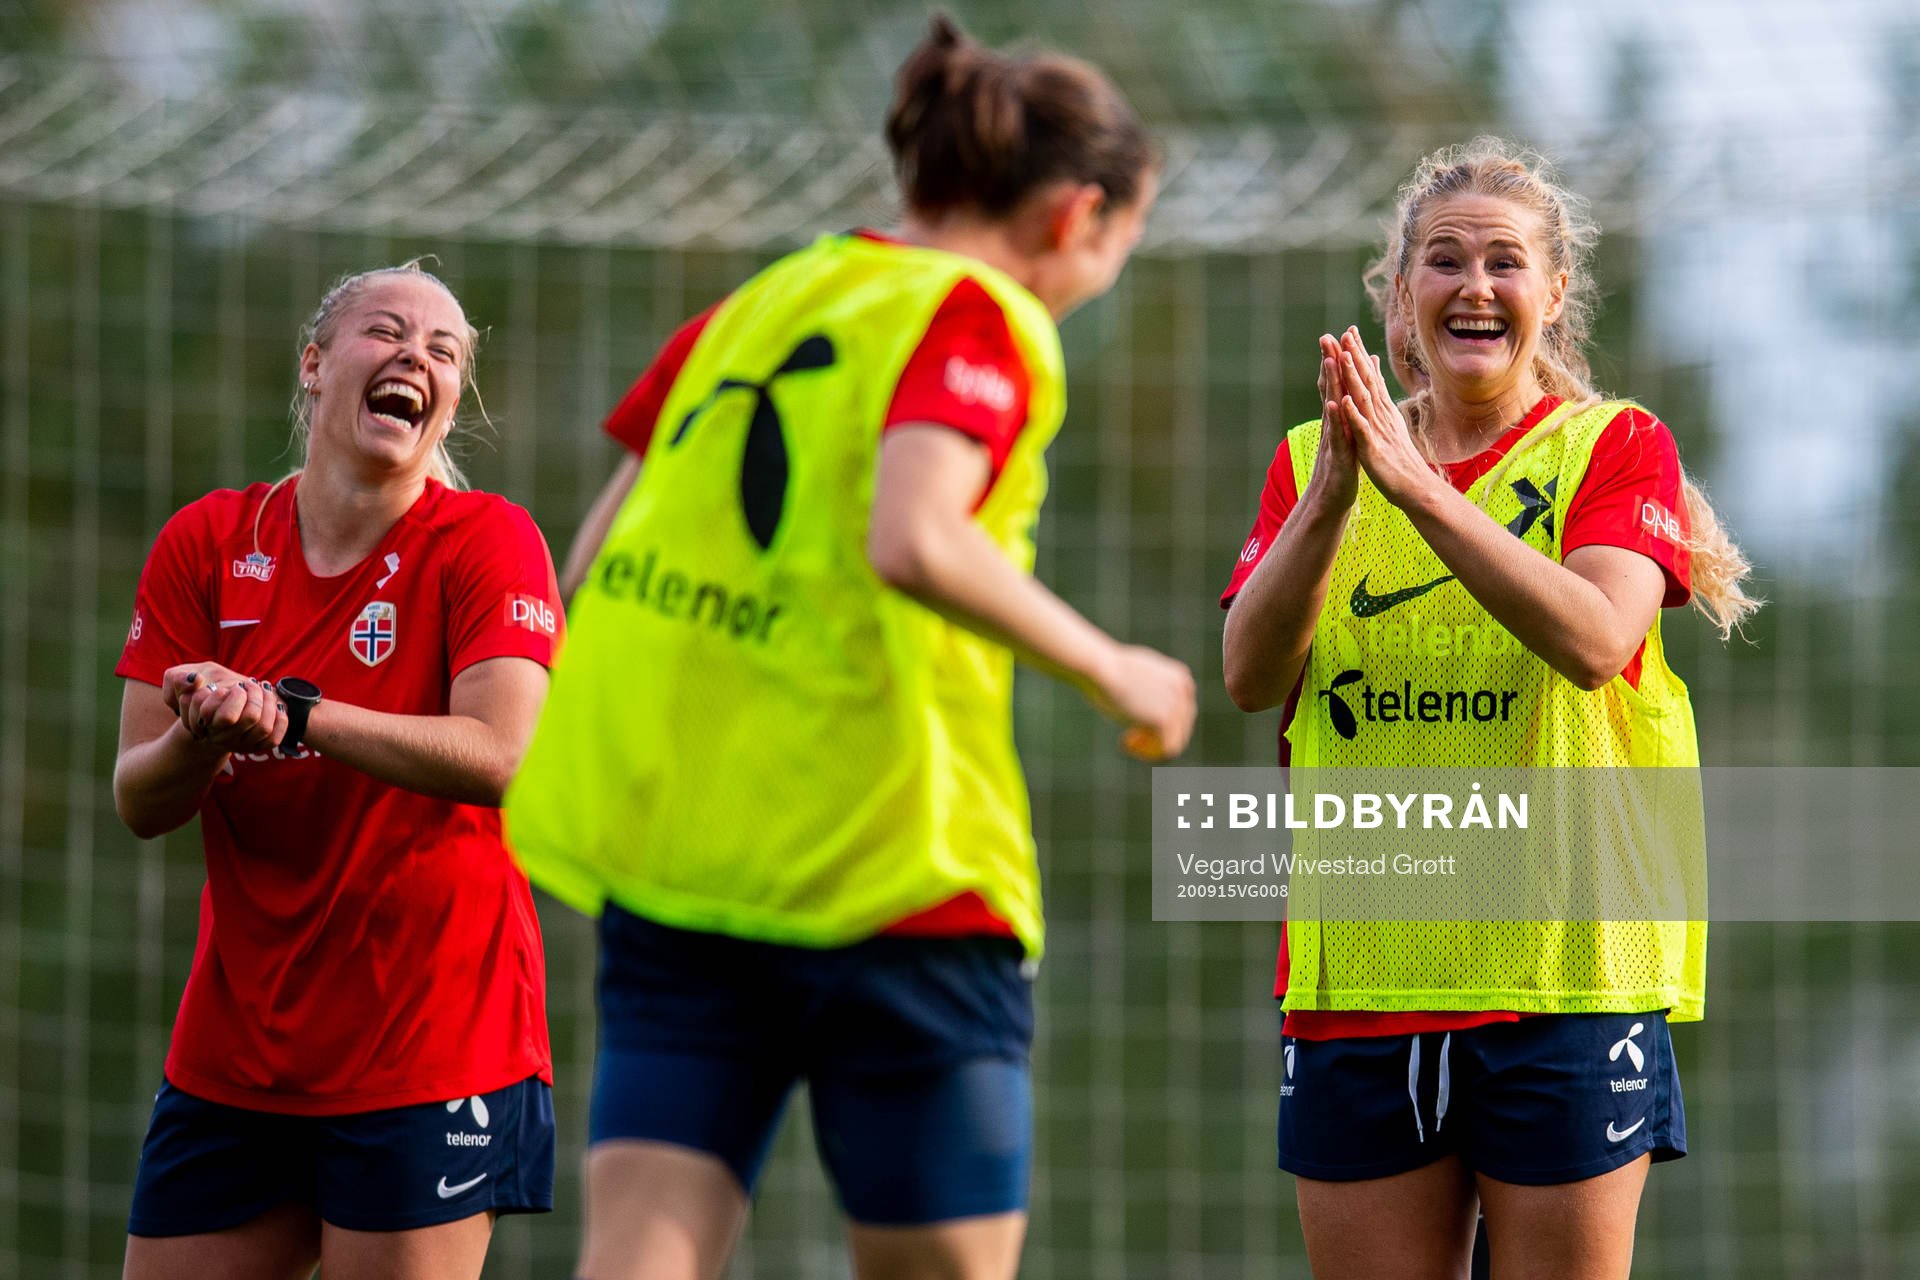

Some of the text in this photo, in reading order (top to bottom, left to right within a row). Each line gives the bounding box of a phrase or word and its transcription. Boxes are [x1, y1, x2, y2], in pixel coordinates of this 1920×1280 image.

[1642, 503, 1680, 541] DNB
[1240, 537, 1260, 562] NB
[238, 563, 271, 578] TINE
[600, 547, 780, 643] elenor
[512, 599, 555, 634] DNB
[1361, 679, 1519, 723] telenor
[1610, 1077, 1648, 1093] telenor
[446, 1131, 492, 1147] telenor
